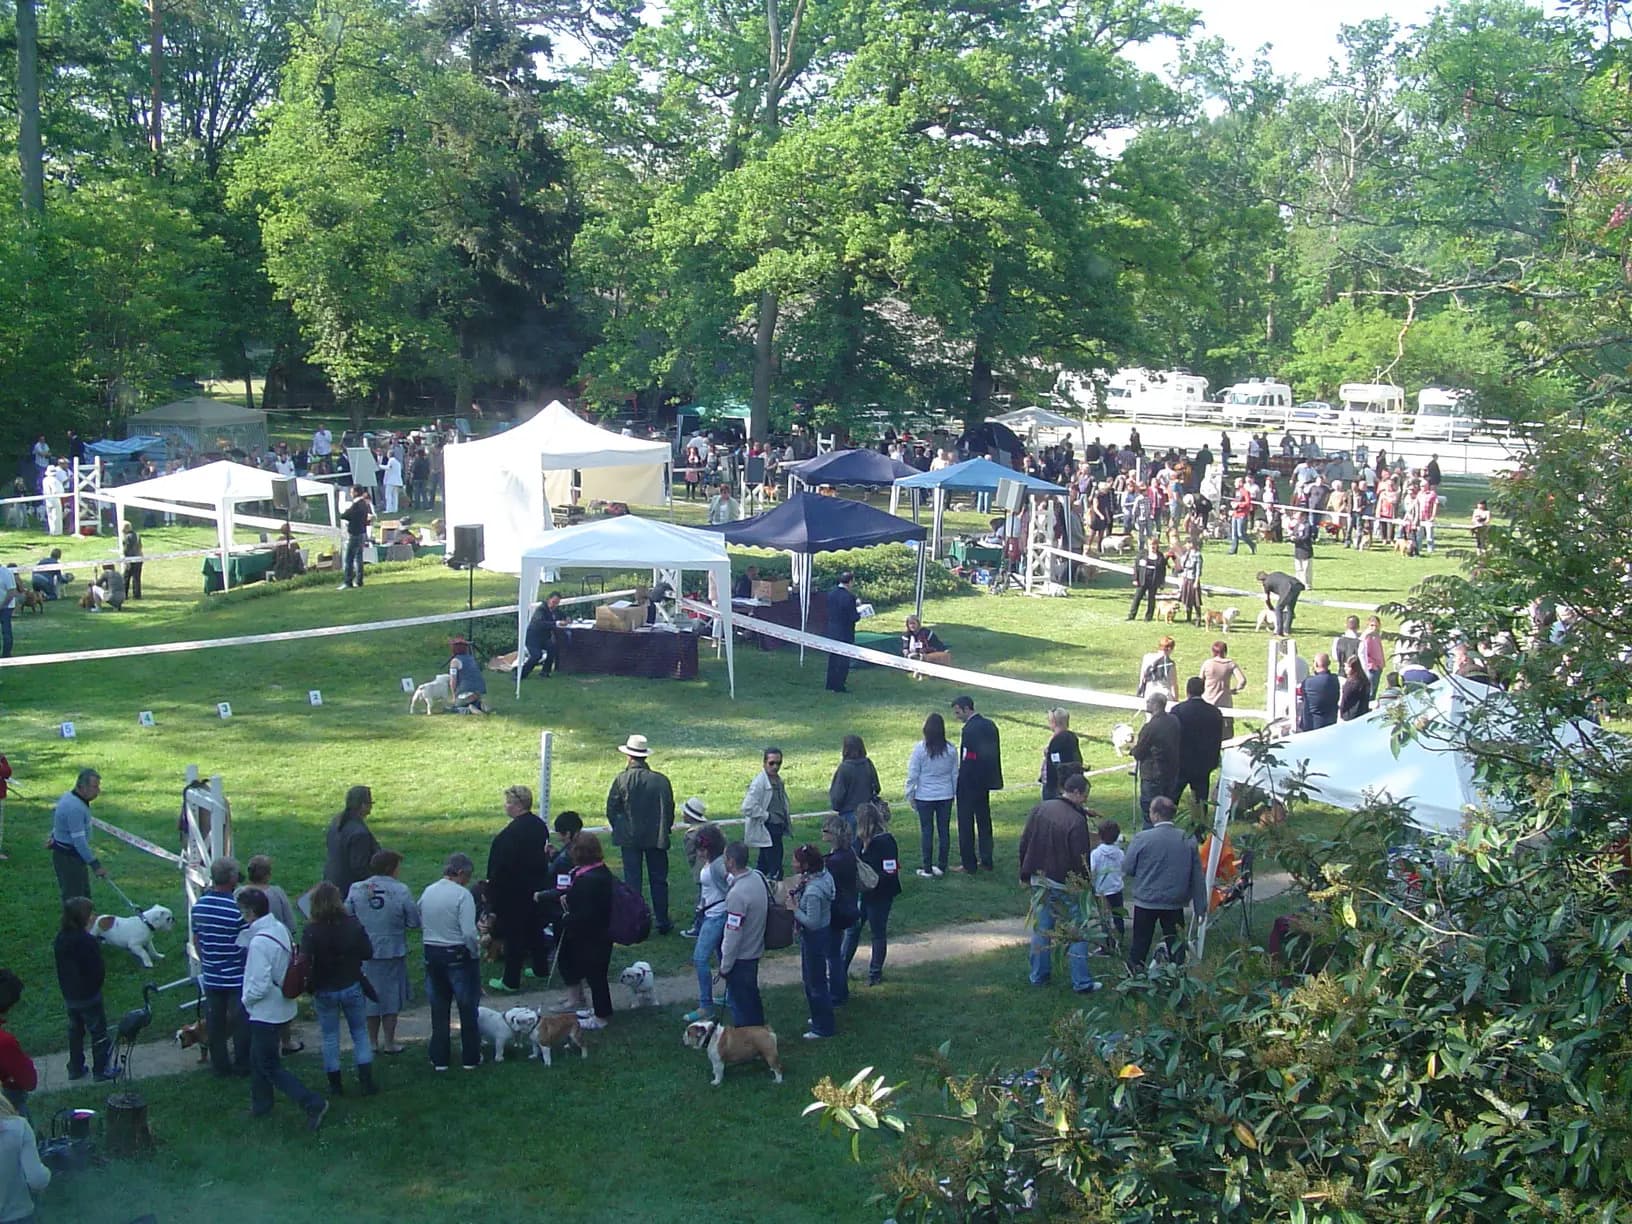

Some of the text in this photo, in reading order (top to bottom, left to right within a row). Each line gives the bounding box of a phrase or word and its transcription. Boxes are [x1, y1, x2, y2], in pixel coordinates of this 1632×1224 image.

[221, 704, 228, 712] 3
[144, 713, 151, 721] 4
[65, 724, 72, 733] 5
[368, 890, 385, 910] 5
